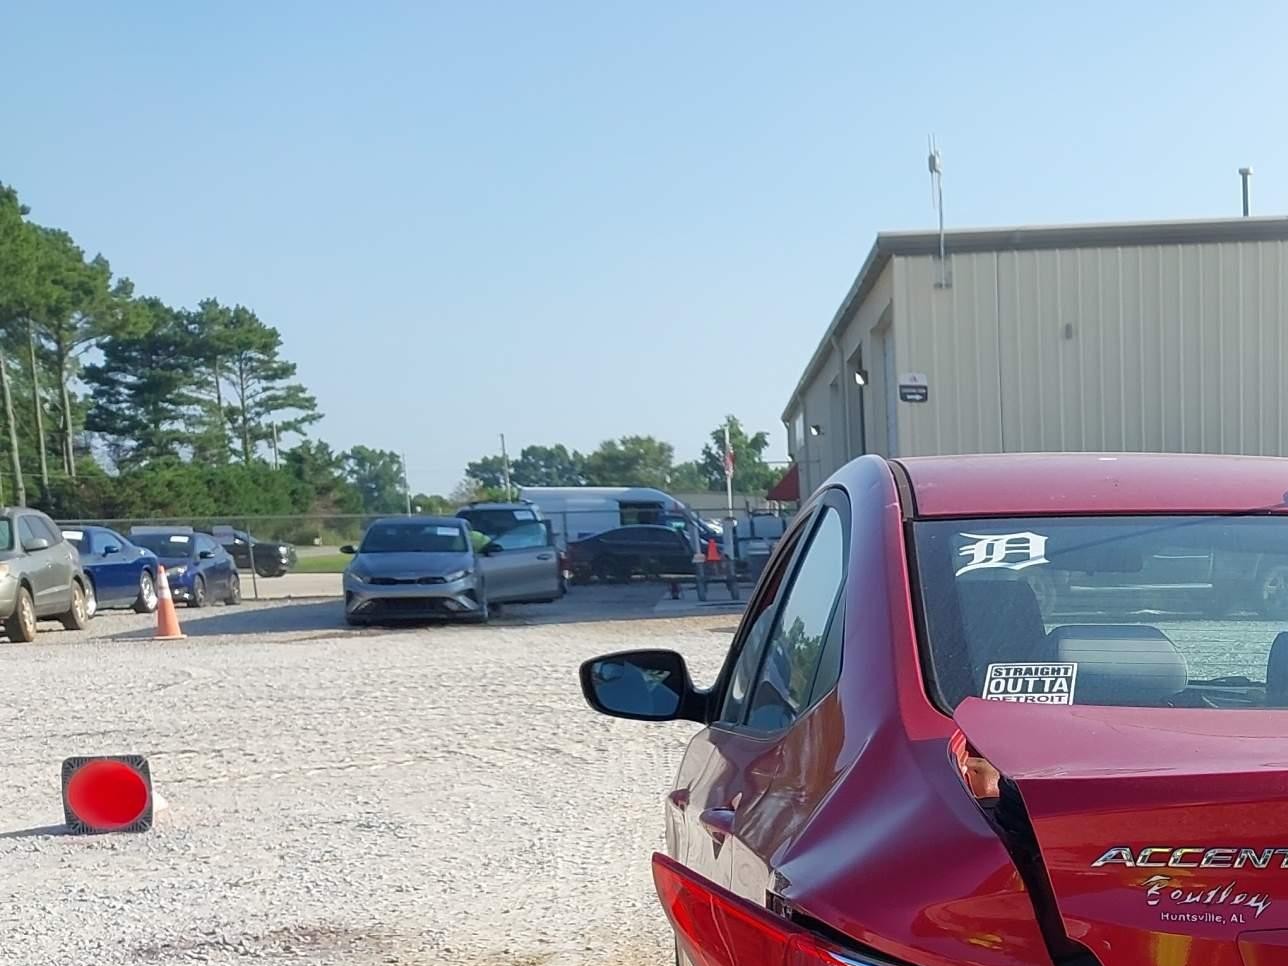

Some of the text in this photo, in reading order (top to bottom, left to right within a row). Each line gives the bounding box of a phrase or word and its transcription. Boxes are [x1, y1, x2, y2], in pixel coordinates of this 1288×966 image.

[993, 667, 1071, 677] STRAIGHT
[989, 677, 1069, 693] OUTTA
[1161, 912, 1246, 925] Huntsville, AL
